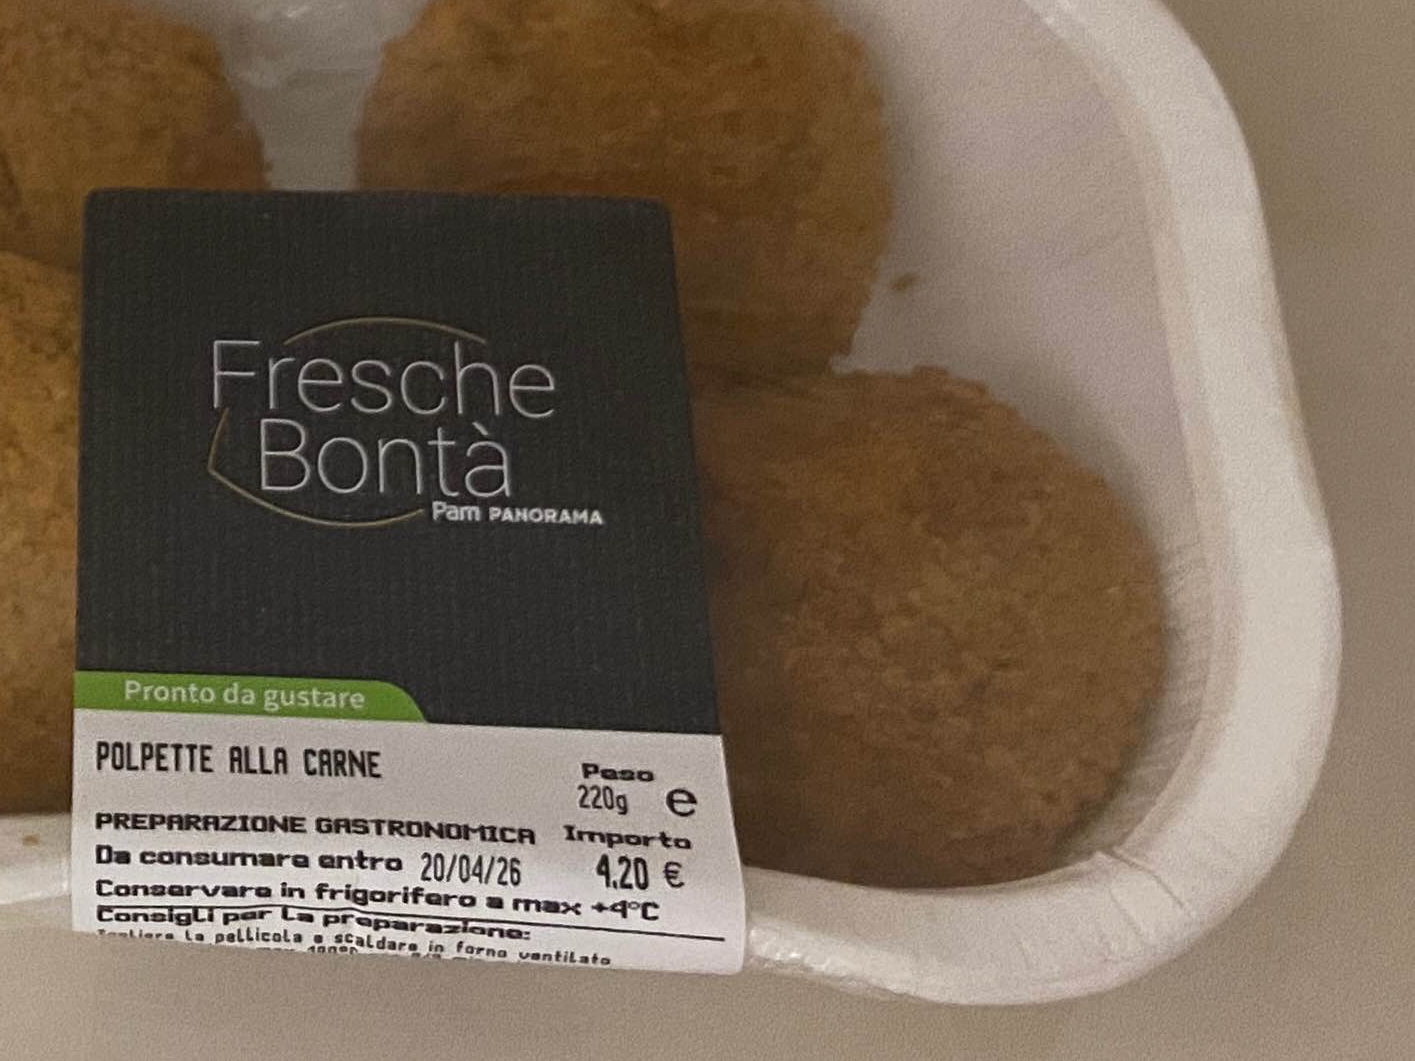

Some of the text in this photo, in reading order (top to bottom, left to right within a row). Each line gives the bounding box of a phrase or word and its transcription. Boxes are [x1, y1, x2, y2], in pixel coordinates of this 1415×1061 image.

[212, 339, 556, 419] Fresche
[259, 418, 512, 498] Bontà
[431, 501, 605, 526] Pam PANORAMA
[124, 680, 366, 712] Pronto da gustare
[95, 741, 382, 778] POLPETTE ALLA CARNE
[581, 763, 655, 783] Peso
[577, 785, 628, 816] 220g
[95, 812, 536, 845] PREPARAZIONE GASTRONOMICA
[563, 825, 692, 850] Importo
[95, 844, 522, 887] Da consumare entro 20/04/26
[663, 861, 685, 889] €
[95, 879, 660, 922] Conservare in frigorifero a max +4°C
[96, 905, 531, 940] Consigli per la preparazione:
[185, 929, 204, 942] la
[215, 927, 303, 945] pellicola
[334, 932, 418, 952] scaldare
[428, 940, 444, 953] in
[456, 940, 508, 959] forno
[518, 949, 612, 966] ventilato
